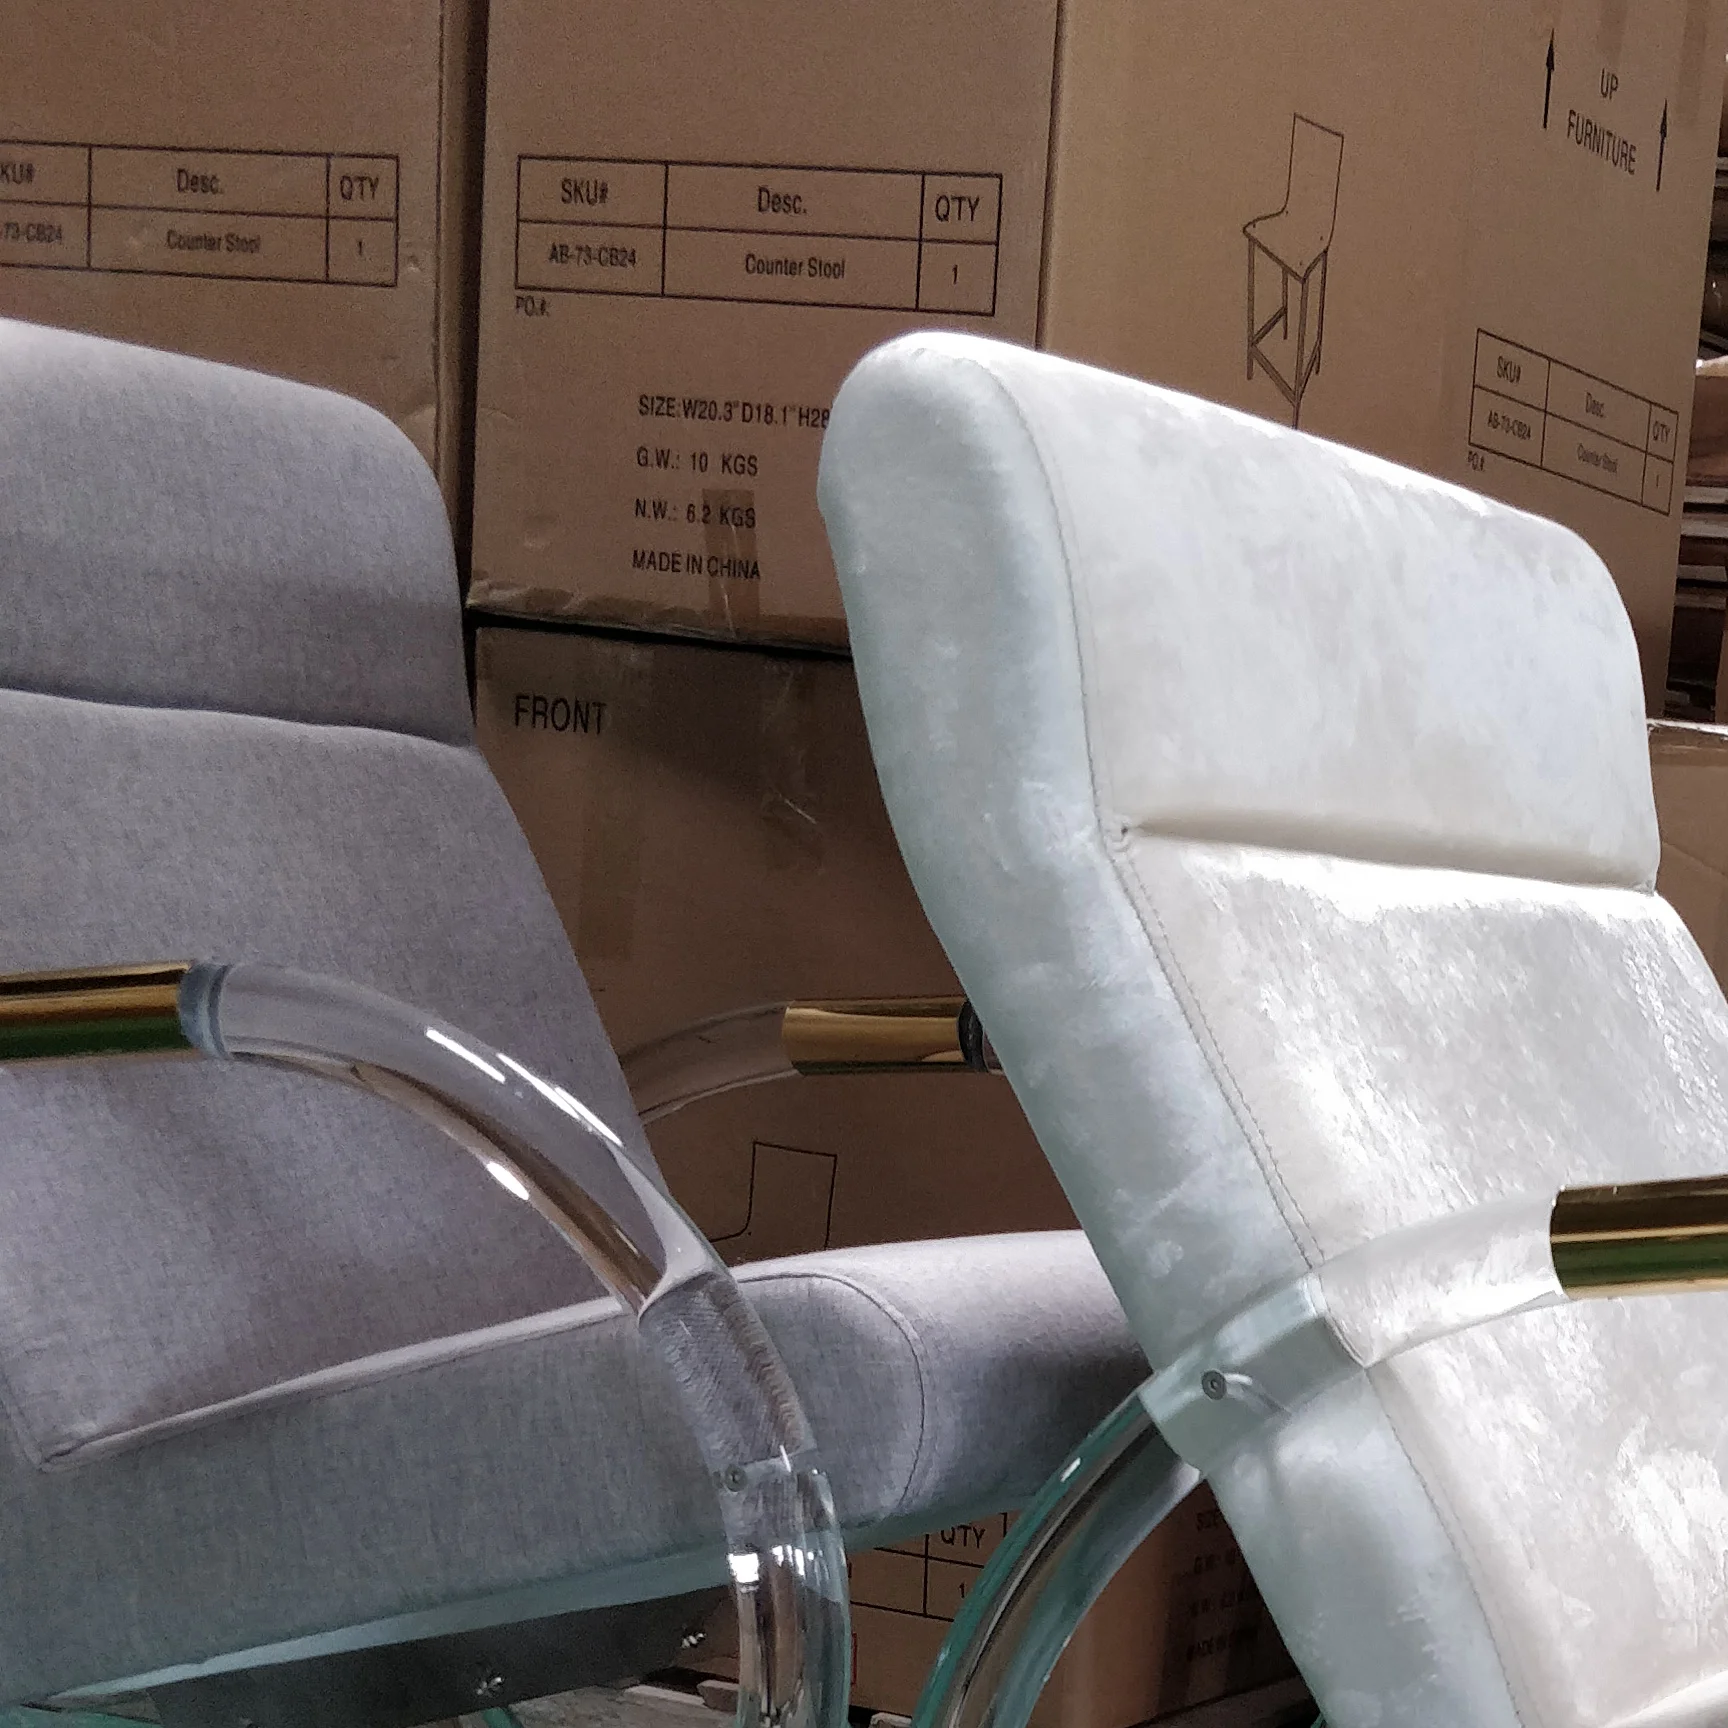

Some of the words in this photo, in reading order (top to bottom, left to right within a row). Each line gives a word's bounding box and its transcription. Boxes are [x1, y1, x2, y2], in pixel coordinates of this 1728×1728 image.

[1599, 67, 1620, 101] UP
[1566, 109, 1637, 176] FURNITURE
[0, 163, 34, 185] KU#
[339, 174, 380, 201] QTY
[560, 177, 609, 206] SKU#
[756, 185, 808, 215] Desc.
[934, 194, 980, 222] QTY
[548, 241, 637, 268] AB-73-CB24
[745, 253, 803, 277] Counter
[807, 255, 846, 280] Stool
[952, 263, 959, 285] 1
[690, 451, 708, 473] 10
[721, 451, 759, 477] KGS
[719, 505, 757, 529] KGS
[632, 549, 682, 574] MADE
[686, 553, 703, 575] IN
[707, 555, 761, 580] CHINA
[514, 693, 608, 736] FRONT
[940, 1523, 986, 1550] QTY
[958, 1582, 965, 1599] 1
